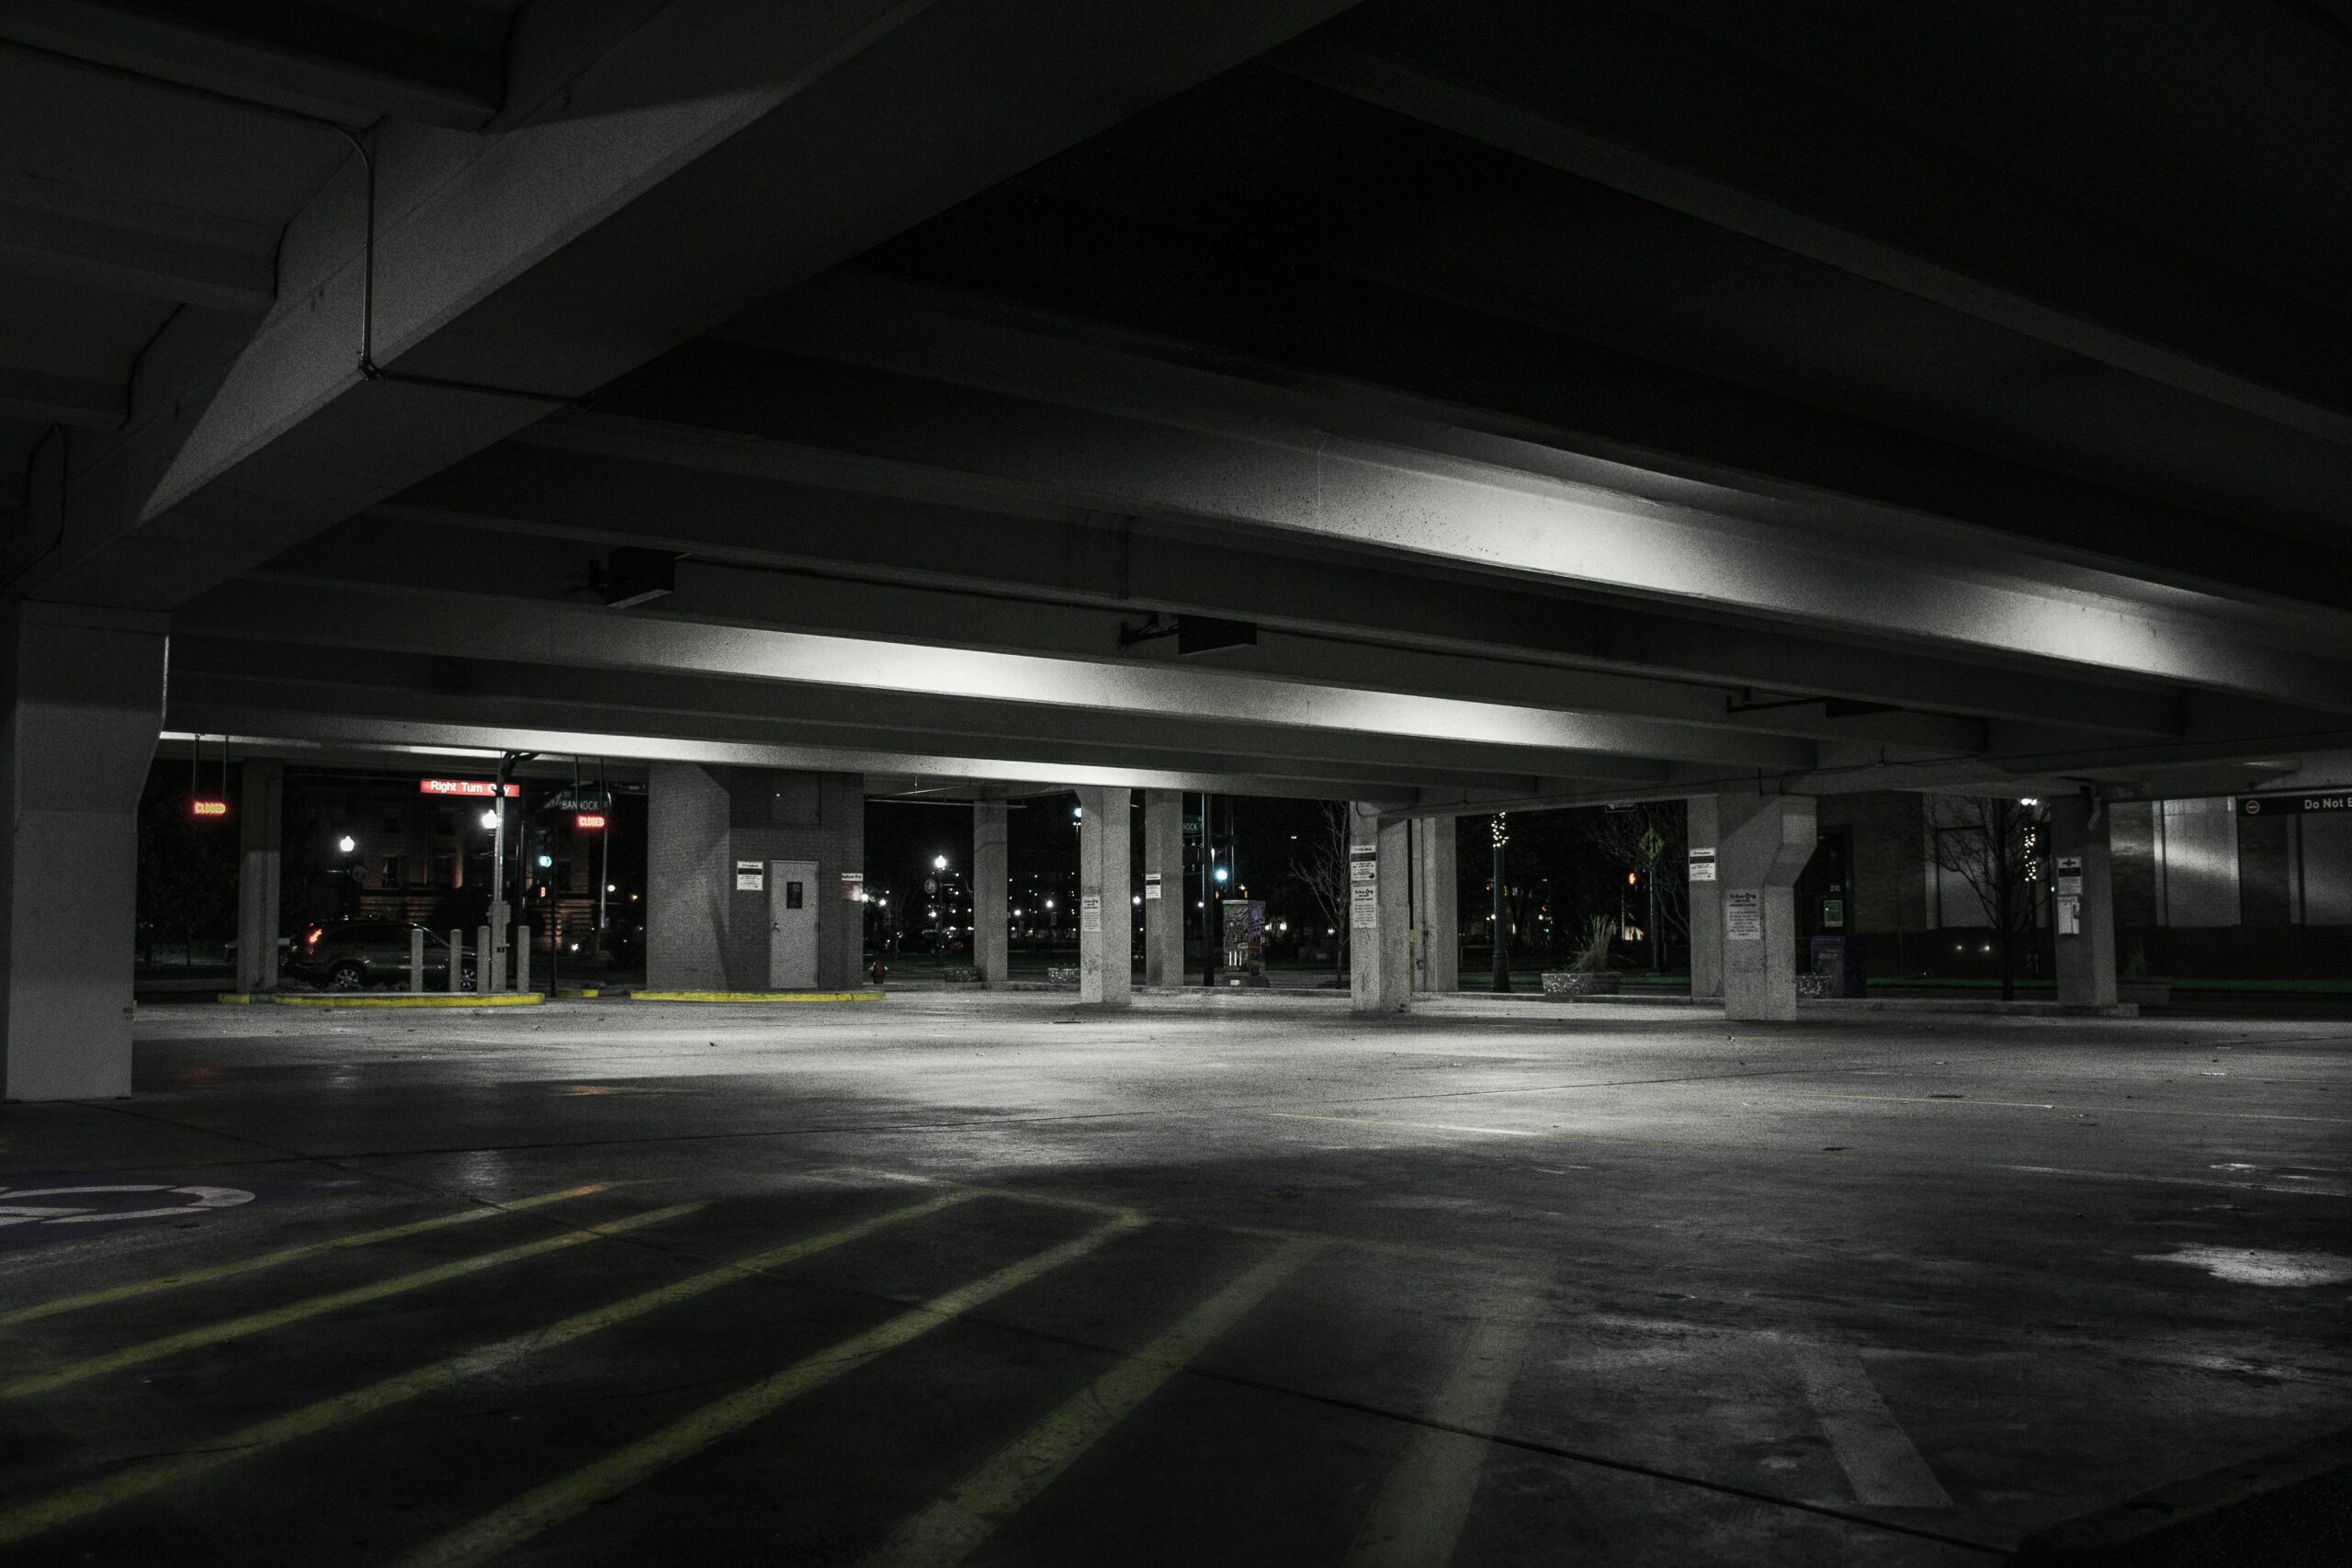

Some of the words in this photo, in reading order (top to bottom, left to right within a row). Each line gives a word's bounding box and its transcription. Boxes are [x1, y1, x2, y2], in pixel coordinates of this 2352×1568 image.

[431, 780, 457, 793] Right
[462, 782, 483, 793] Turn
[488, 784, 511, 796] Oy
[194, 801, 226, 814] CLOSED
[561, 800, 599, 810] BANNOCK
[2303, 799, 2320, 809] Do
[2323, 797, 2344, 808] Not
